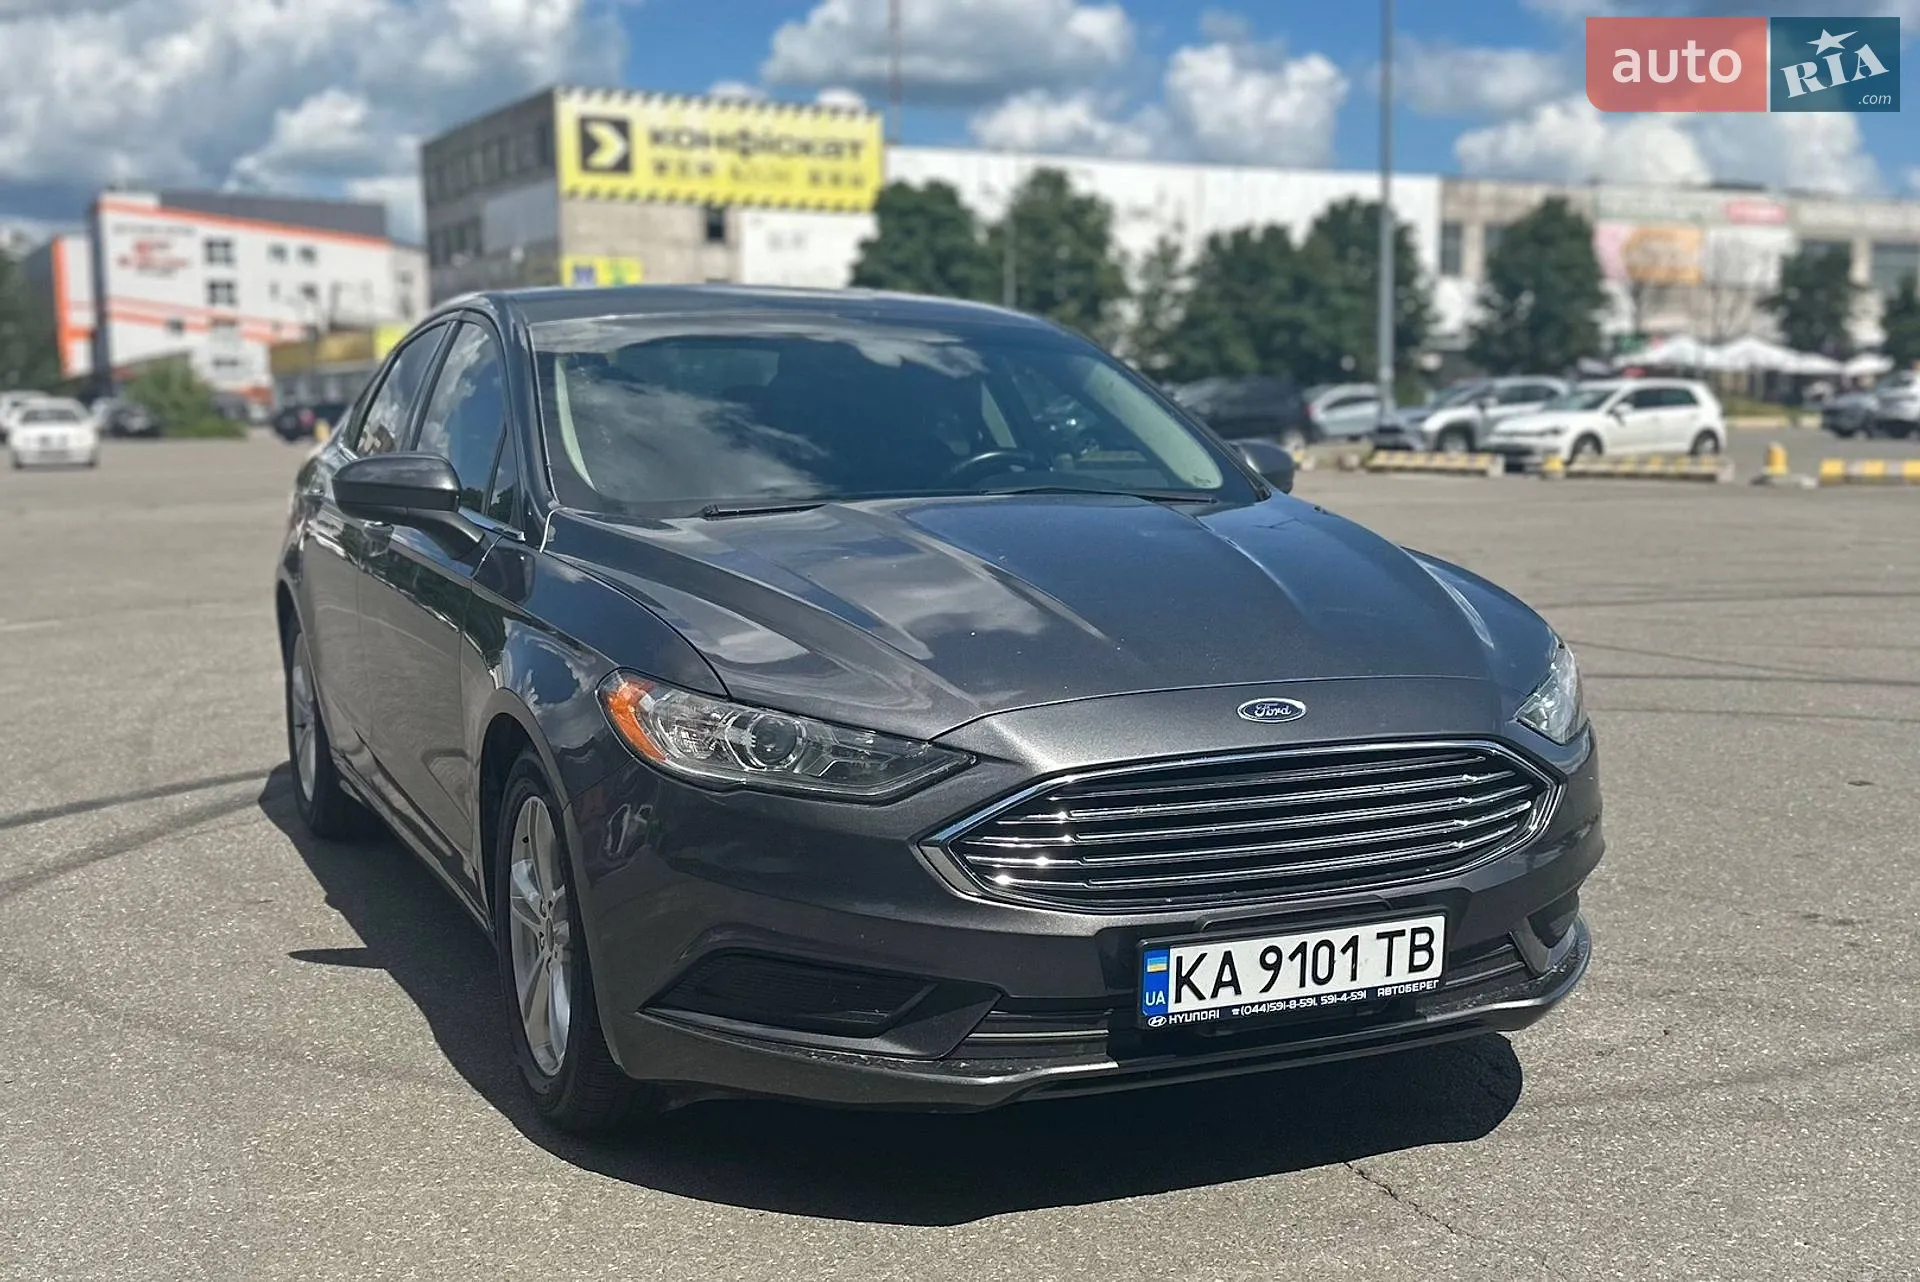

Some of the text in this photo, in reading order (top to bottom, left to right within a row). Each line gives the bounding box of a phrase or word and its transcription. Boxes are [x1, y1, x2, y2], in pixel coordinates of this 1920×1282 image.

[1254, 703, 1292, 717] Ford
[1174, 926, 1436, 1004] KA 9101 TB
[1145, 991, 1166, 1006] UA
[1168, 1009, 1220, 1025] HYUNDAI
[1320, 990, 1367, 1006] 591-4-591
[1377, 980, 1439, 998] АВТОБЕРЕГ
